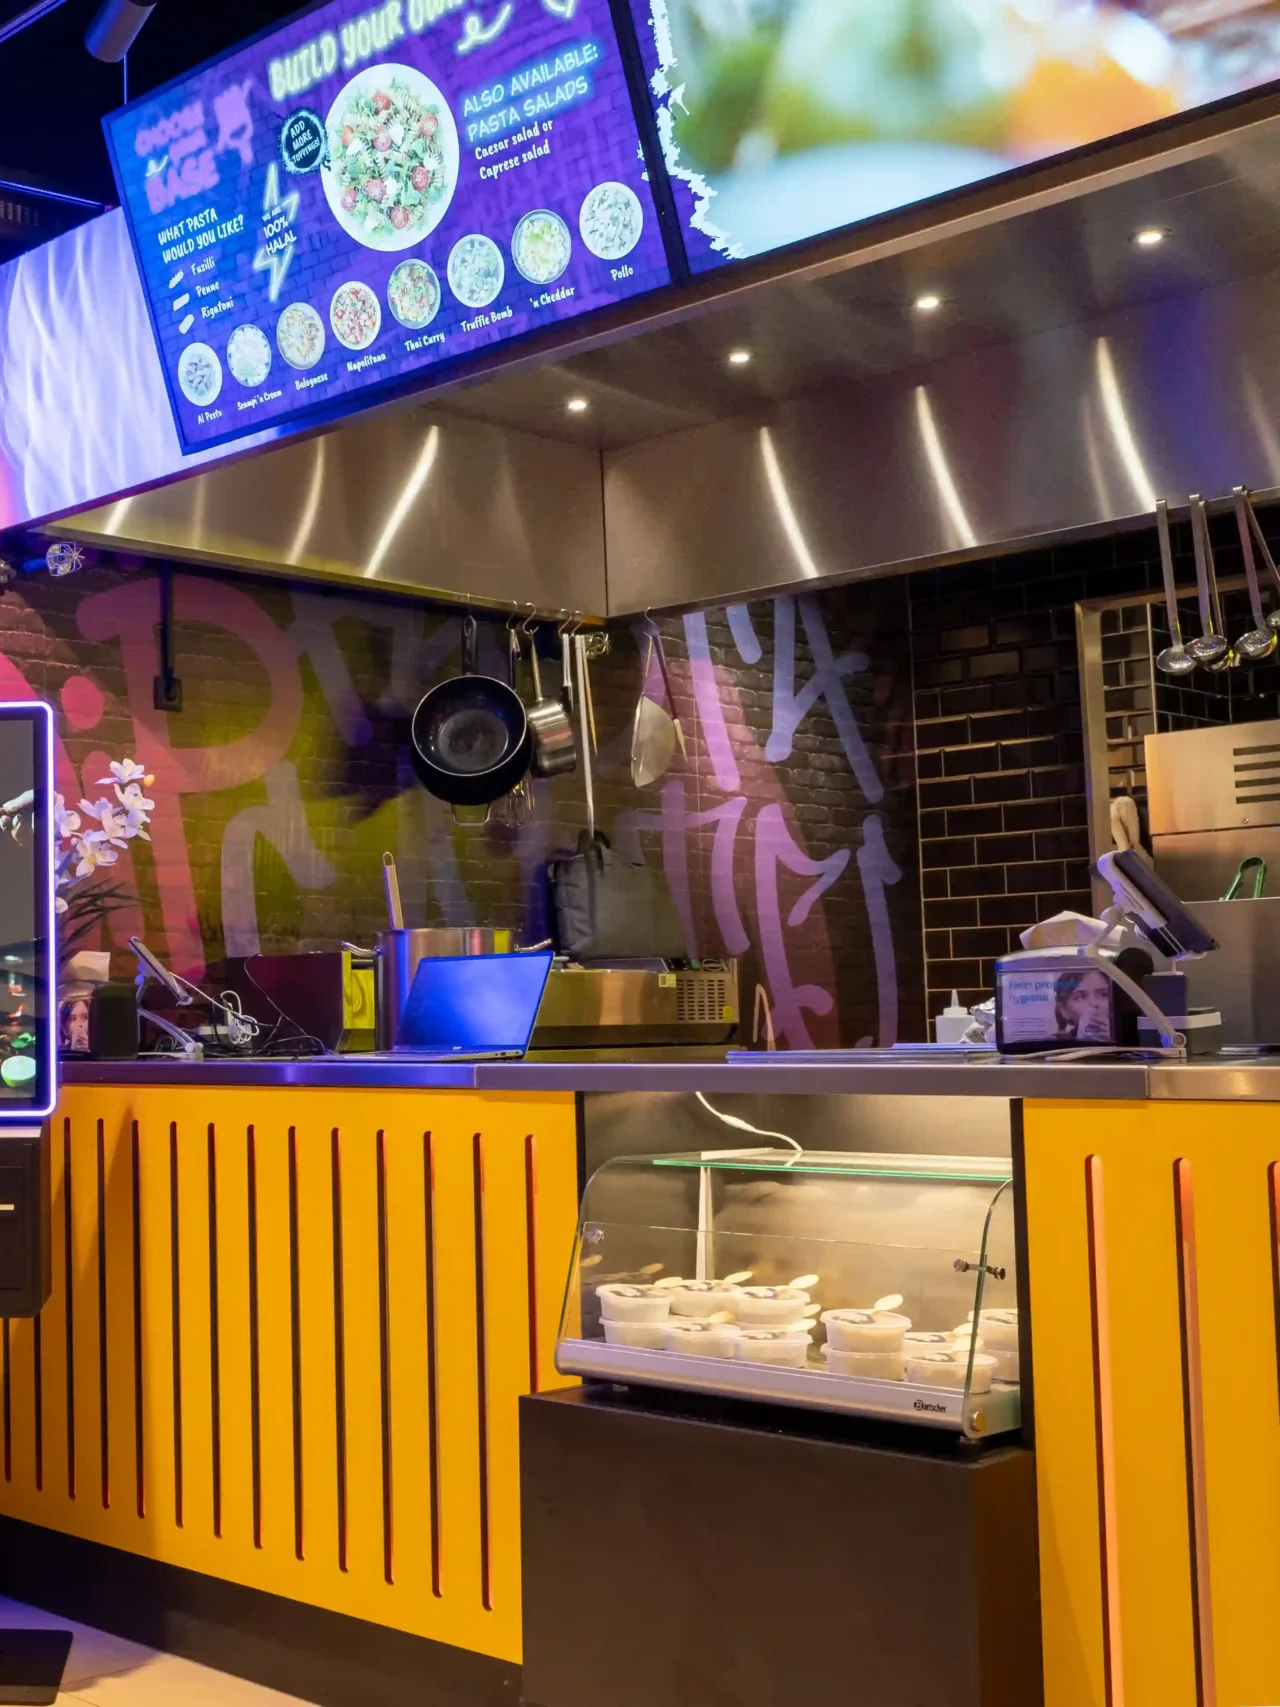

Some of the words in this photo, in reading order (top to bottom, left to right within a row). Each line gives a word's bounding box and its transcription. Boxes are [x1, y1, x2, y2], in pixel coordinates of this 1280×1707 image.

[270, 35, 336, 100] BUILD
[343, 2, 404, 65] YOUR
[463, 84, 505, 117] ALSO
[511, 43, 599, 96] AVAILABLE:
[467, 107, 520, 142] PASTA
[523, 76, 588, 117] SALADS
[290, 120, 305, 139] ADD
[292, 129, 312, 151] MORE
[475, 139, 509, 160] Caesar
[512, 122, 540, 145] salad
[542, 119, 553, 132] or
[292, 137, 320, 163] TOPPINGS!
[479, 157, 520, 180] Caprese
[522, 139, 551, 163] salad
[262, 213, 271, 222] WE
[271, 206, 281, 217] ARE
[158, 225, 185, 246] WHAT
[187, 208, 218, 233] PASTA
[263, 215, 289, 239] 100%
[163, 235, 195, 264] WOULD
[196, 230, 217, 250] YOU
[217, 214, 244, 239] LIKE?
[265, 229, 297, 256] HALAL
[190, 256, 215, 276] Fusilli
[610, 265, 634, 282] Pollo
[195, 281, 220, 298] Penne
[540, 286, 575, 307] Cheddar
[201, 296, 235, 319] Rigatoni
[460, 312, 490, 333] Truffle
[490, 306, 513, 323] Bomb
[404, 338, 422, 352] Thai
[423, 331, 446, 347] Curry
[295, 372, 329, 391] Bolognese
[263, 389, 283, 402] Cream
[913, 1399, 947, 1413] Bartscher
